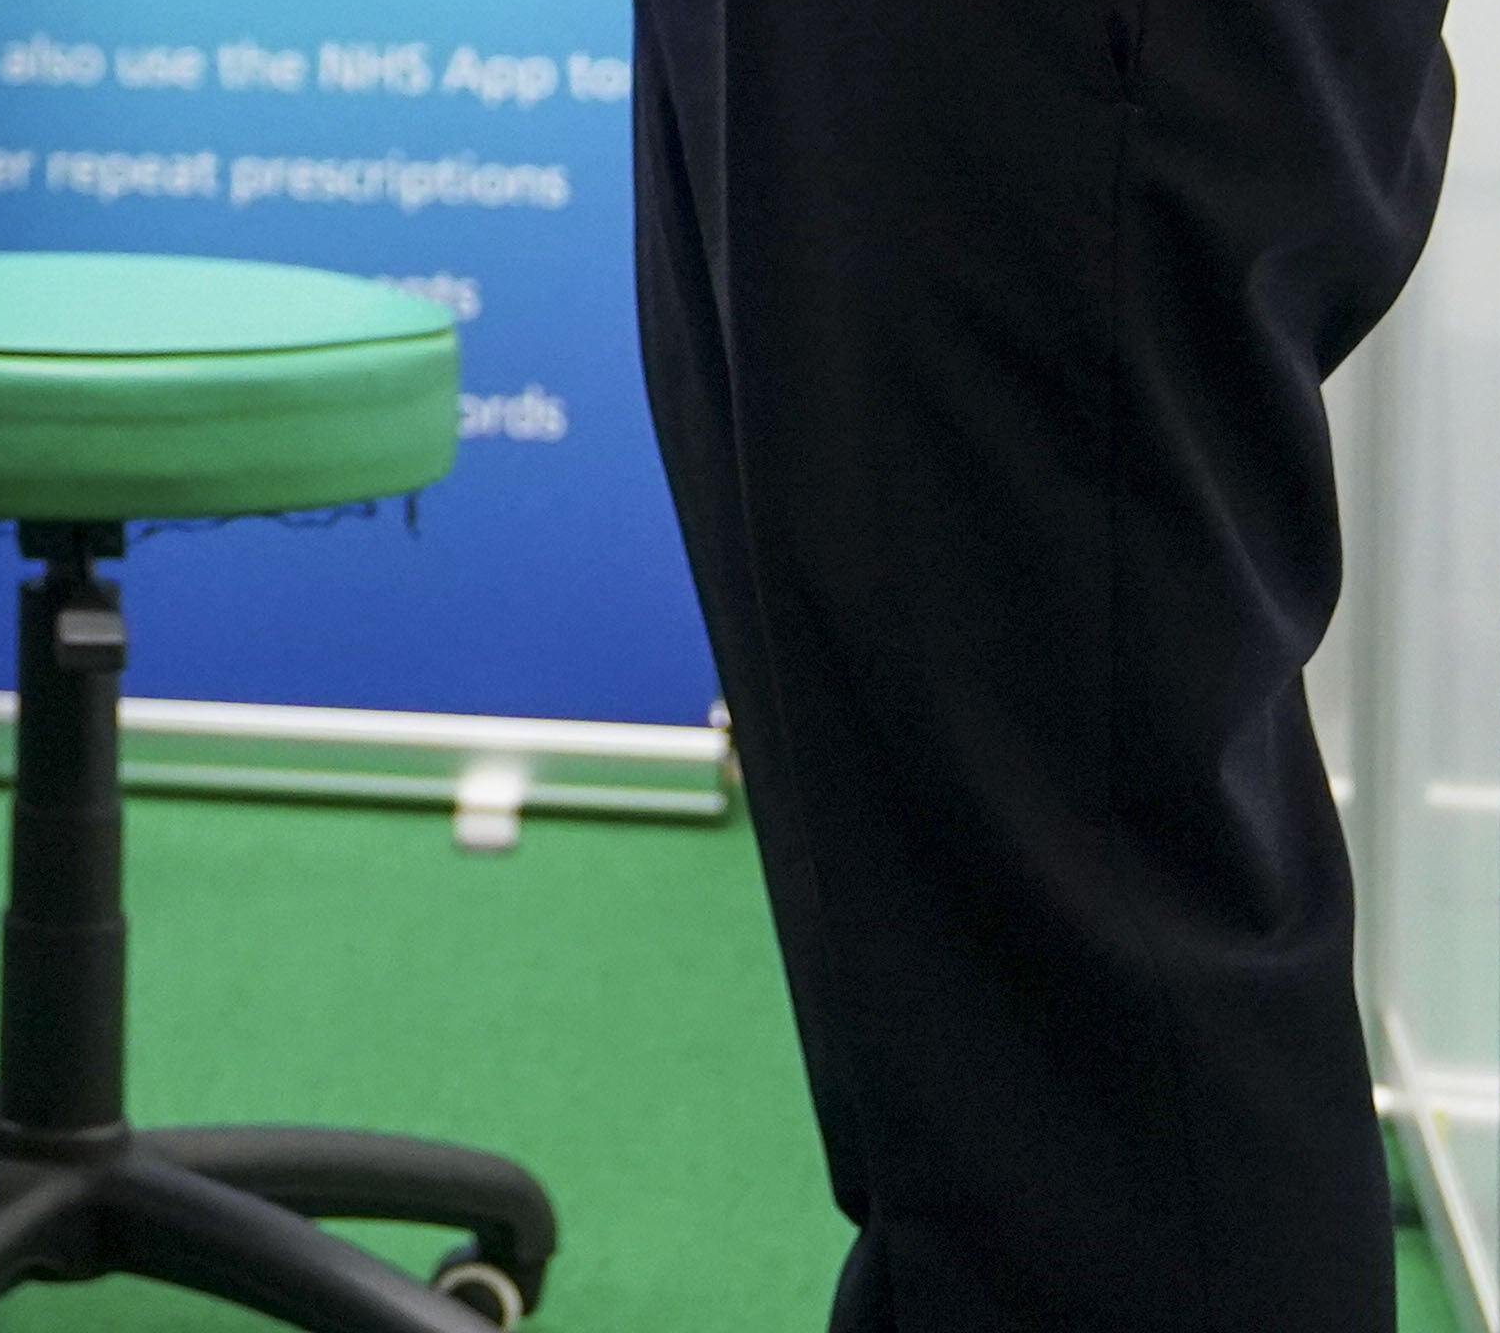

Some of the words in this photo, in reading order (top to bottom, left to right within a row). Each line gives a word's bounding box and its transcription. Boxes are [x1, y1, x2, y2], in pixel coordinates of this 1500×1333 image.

[115, 46, 206, 88] use
[218, 40, 308, 92] the
[318, 41, 432, 96] NHS
[442, 45, 558, 109] App
[46, 149, 218, 205] repeat
[230, 149, 571, 215] prescriptions
[456, 383, 567, 443] ords
